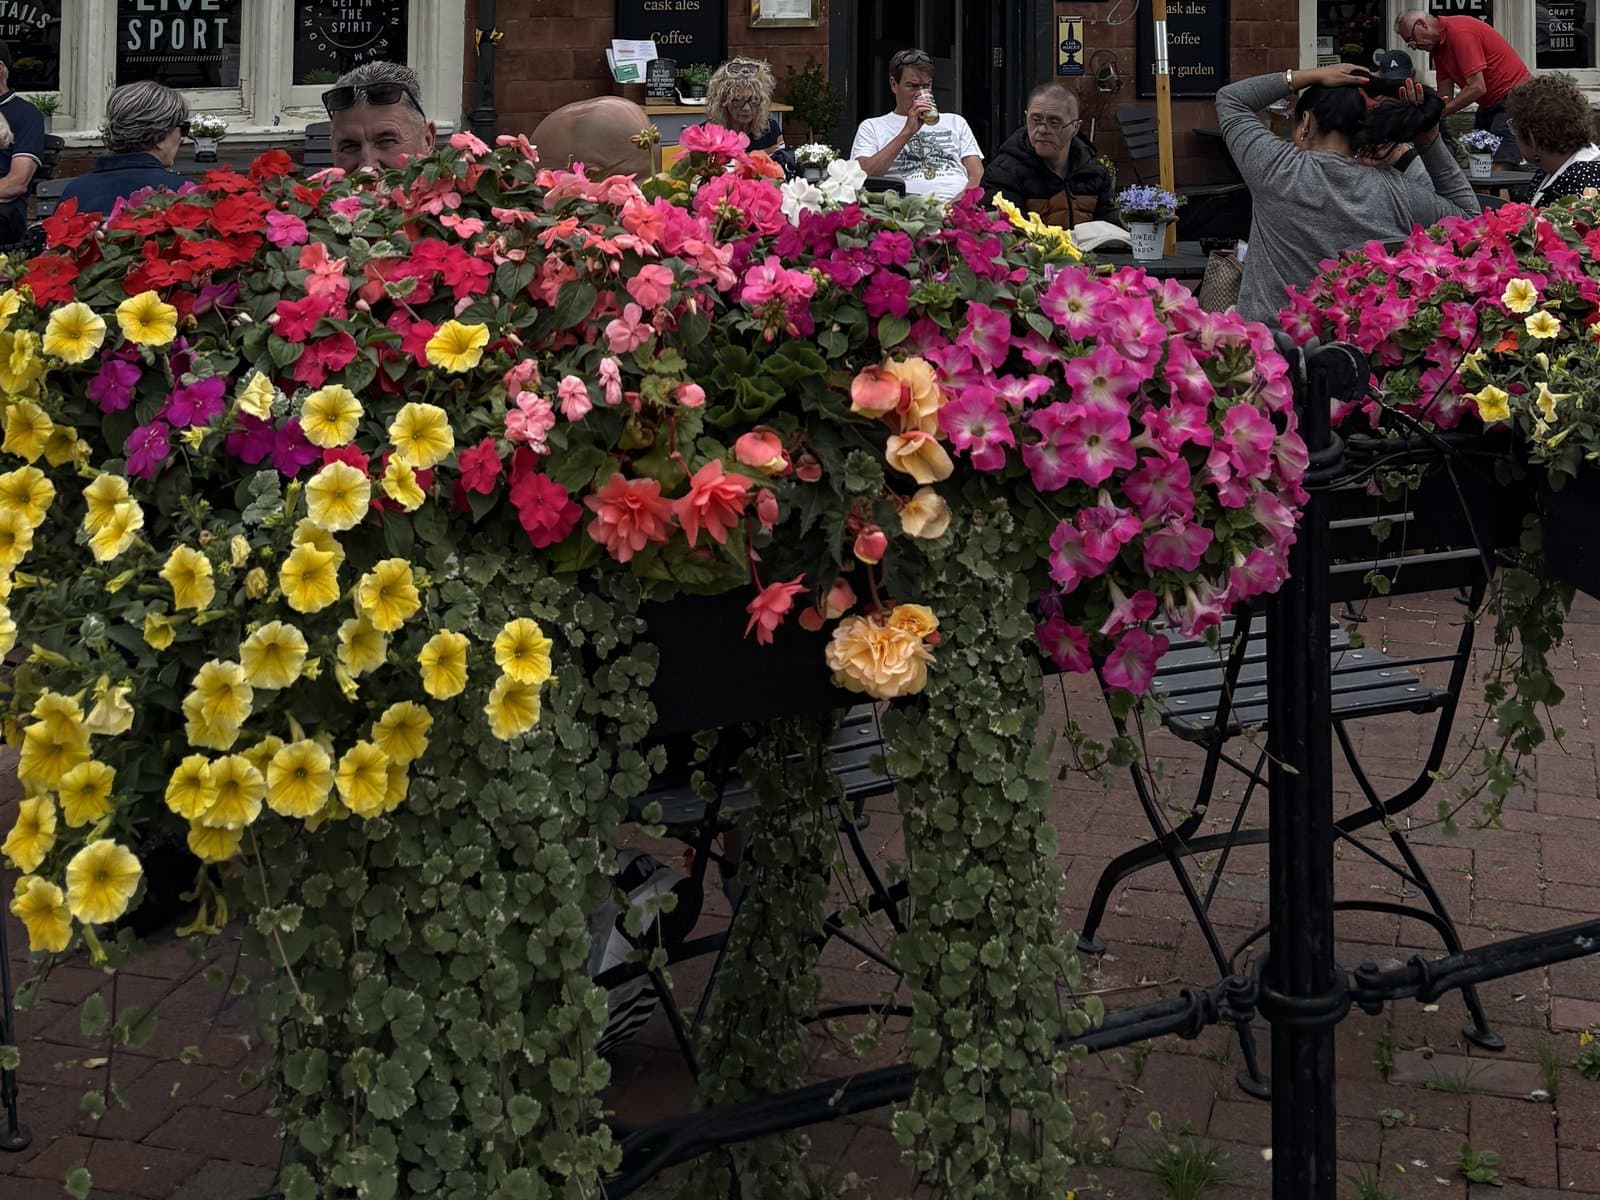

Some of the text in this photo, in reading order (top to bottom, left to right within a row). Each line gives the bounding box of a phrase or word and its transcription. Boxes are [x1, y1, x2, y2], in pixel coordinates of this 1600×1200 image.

[644, 0, 699, 10] cask ales
[1166, 2, 1206, 15] ask ales
[341, 9, 362, 19] THE
[1548, 8, 1574, 16] CRAFT
[8, 24, 20, 35] UP
[331, 22, 372, 33] SPIRIT
[1549, 22, 1574, 32] CASK
[127, 18, 228, 50] SPORT
[650, 30, 693, 44] Coffee
[1167, 31, 1200, 45] Coffee
[1550, 37, 1574, 48] WORLD
[1178, 62, 1214, 78] garden
